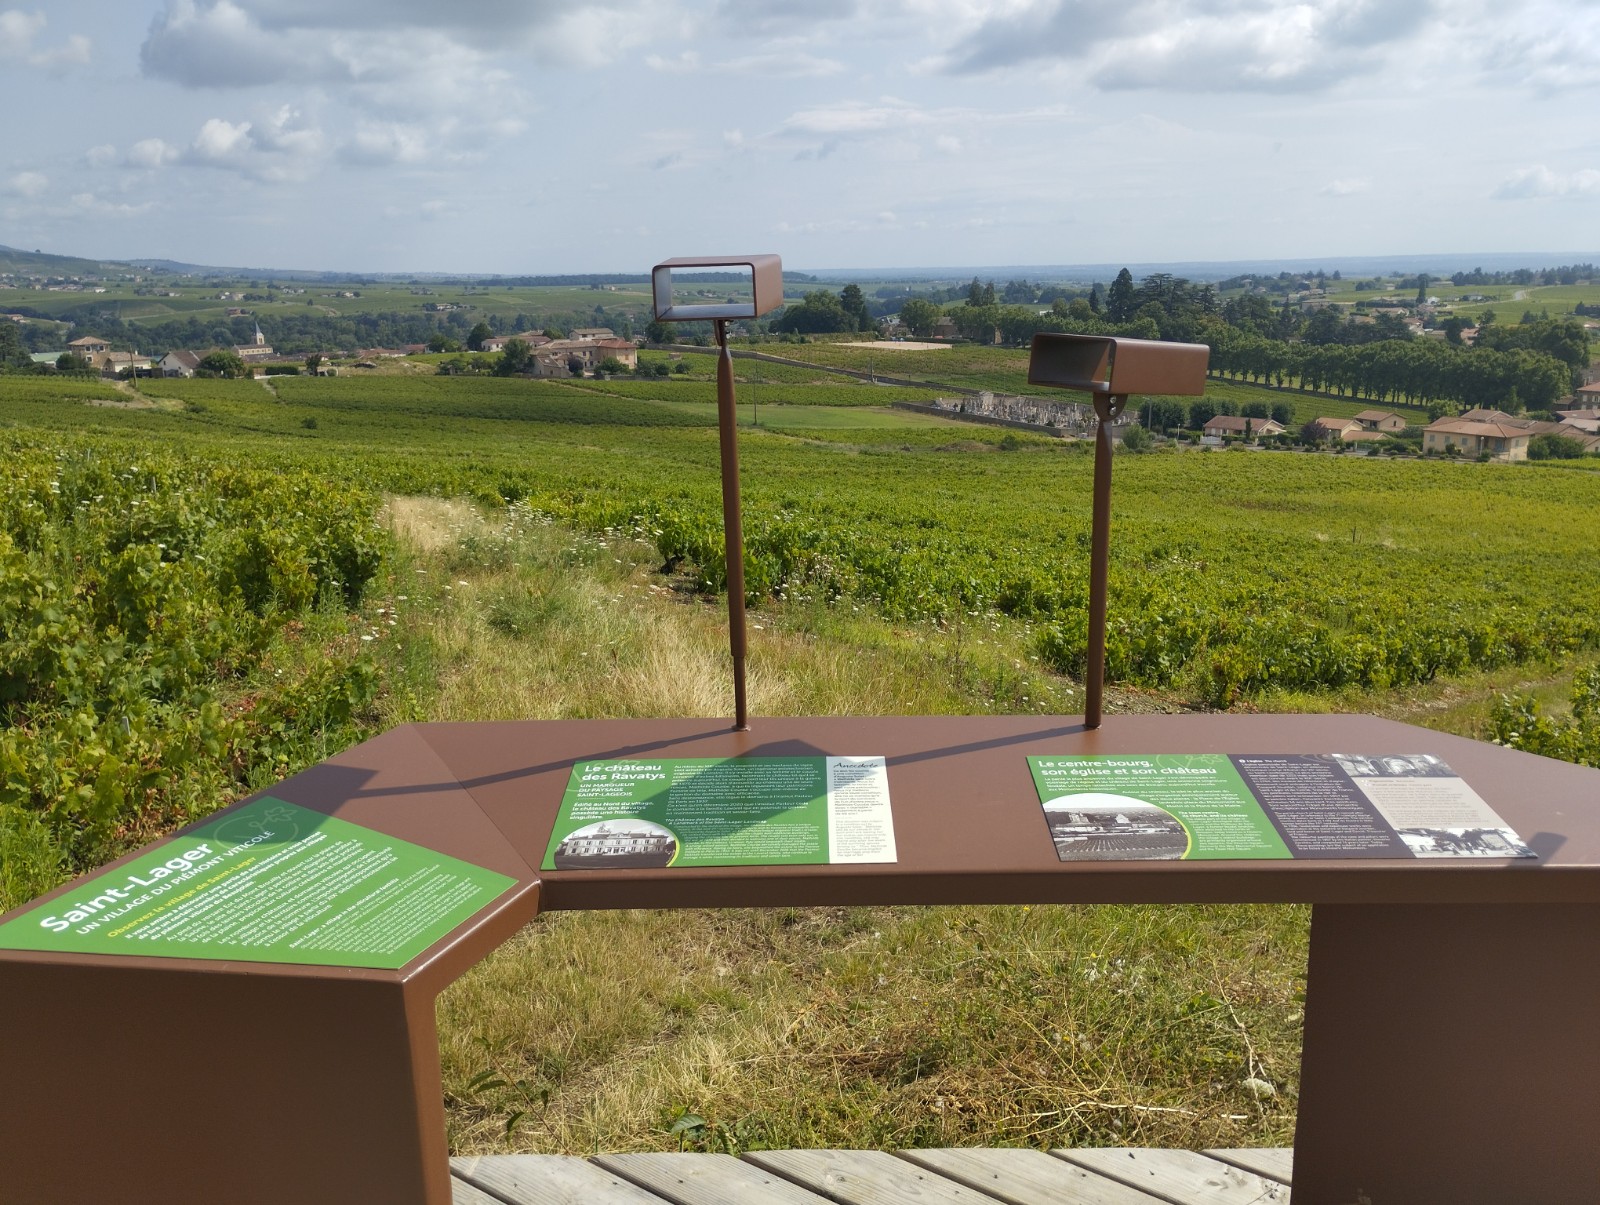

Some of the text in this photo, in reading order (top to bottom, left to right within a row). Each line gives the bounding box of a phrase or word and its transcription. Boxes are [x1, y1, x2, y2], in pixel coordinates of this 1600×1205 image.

[603, 763, 662, 771] château
[1056, 759, 1155, 768] centre-bourg,
[1069, 768, 1112, 776] église
[1158, 766, 1218, 774] château
[610, 772, 666, 781] Ravatys
[74, 829, 275, 934] UN VILLAGE DU PIÉMONT VITICOLE
[40, 843, 213, 934] Saint-Lager
[105, 911, 155, 937] Observez
[163, 888, 198, 907] village
[194, 882, 208, 890] de
[206, 856, 258, 884] Saint-Lager
